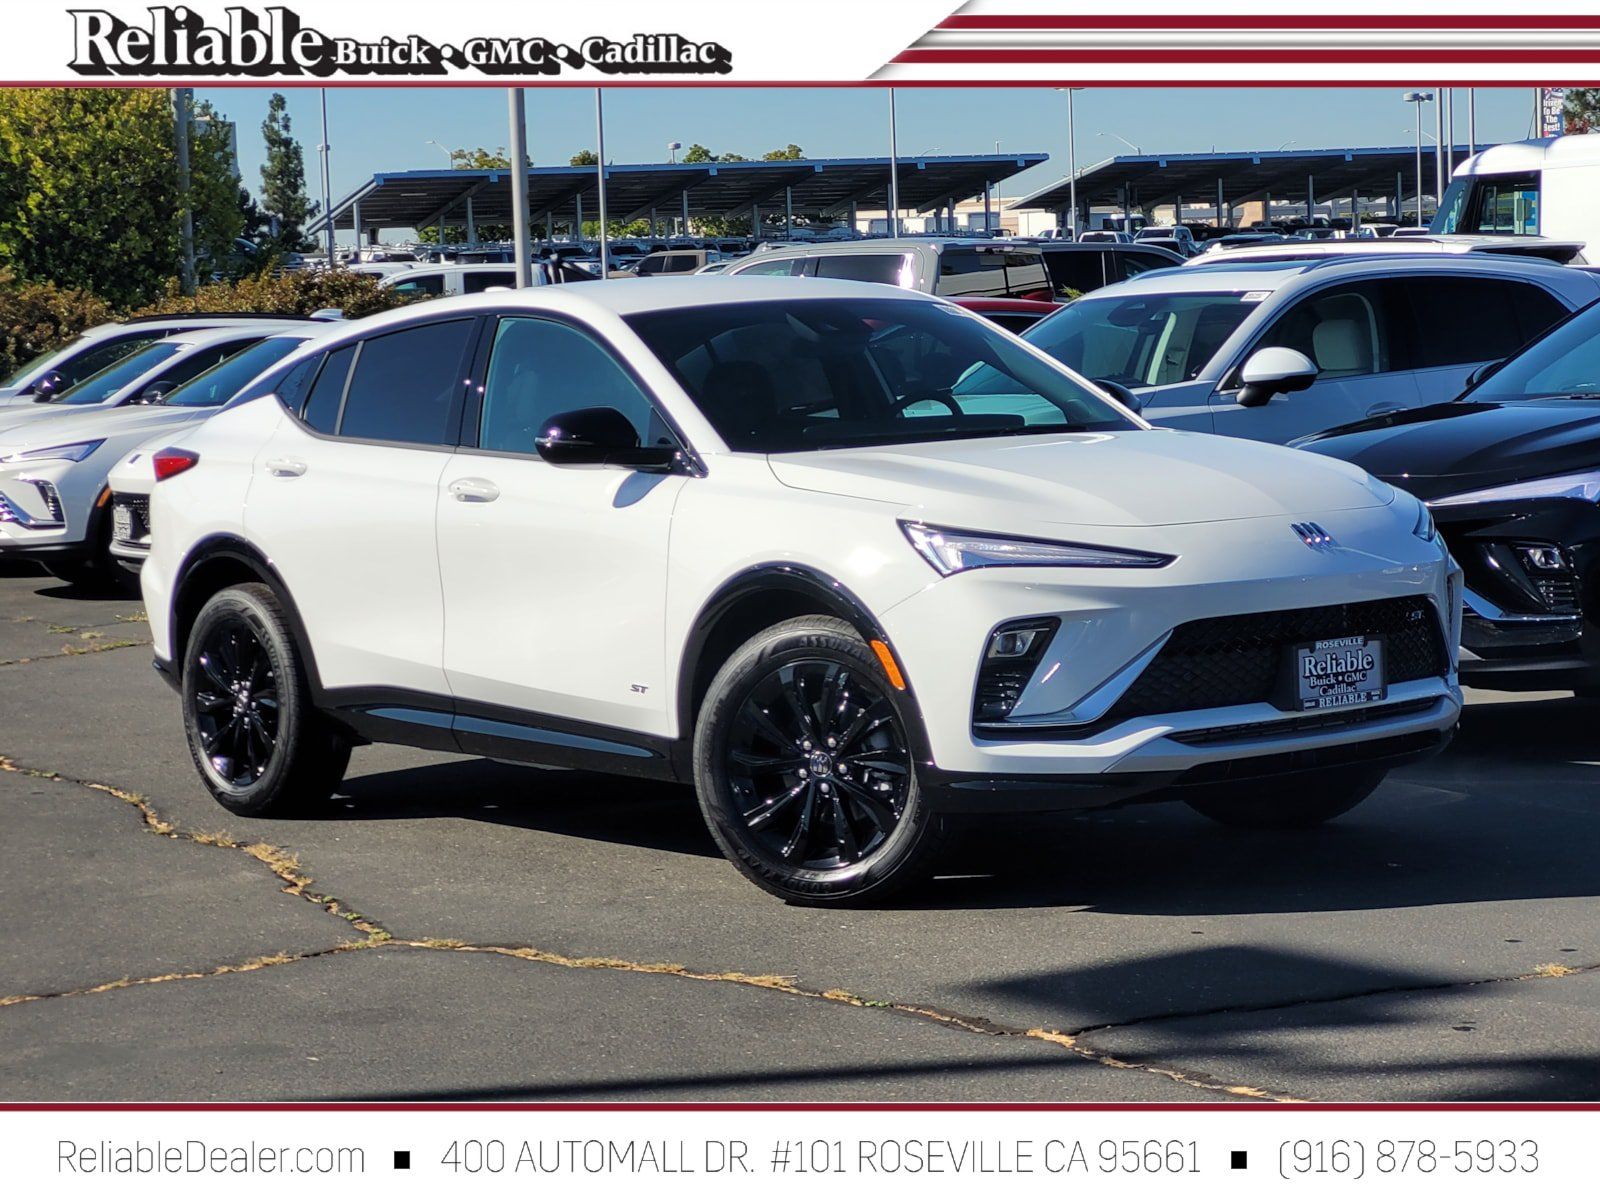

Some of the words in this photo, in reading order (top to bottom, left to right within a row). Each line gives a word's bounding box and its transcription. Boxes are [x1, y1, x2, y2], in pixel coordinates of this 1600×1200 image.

[1315, 638, 1364, 649] ROSEVILLE
[1303, 649, 1373, 677] Reliable
[1310, 674, 1337, 687] Buick
[1344, 670, 1367, 683] GMC
[630, 684, 649, 694] ST
[1319, 683, 1356, 696] Cadillac
[1318, 692, 1368, 708] RELIABLE
